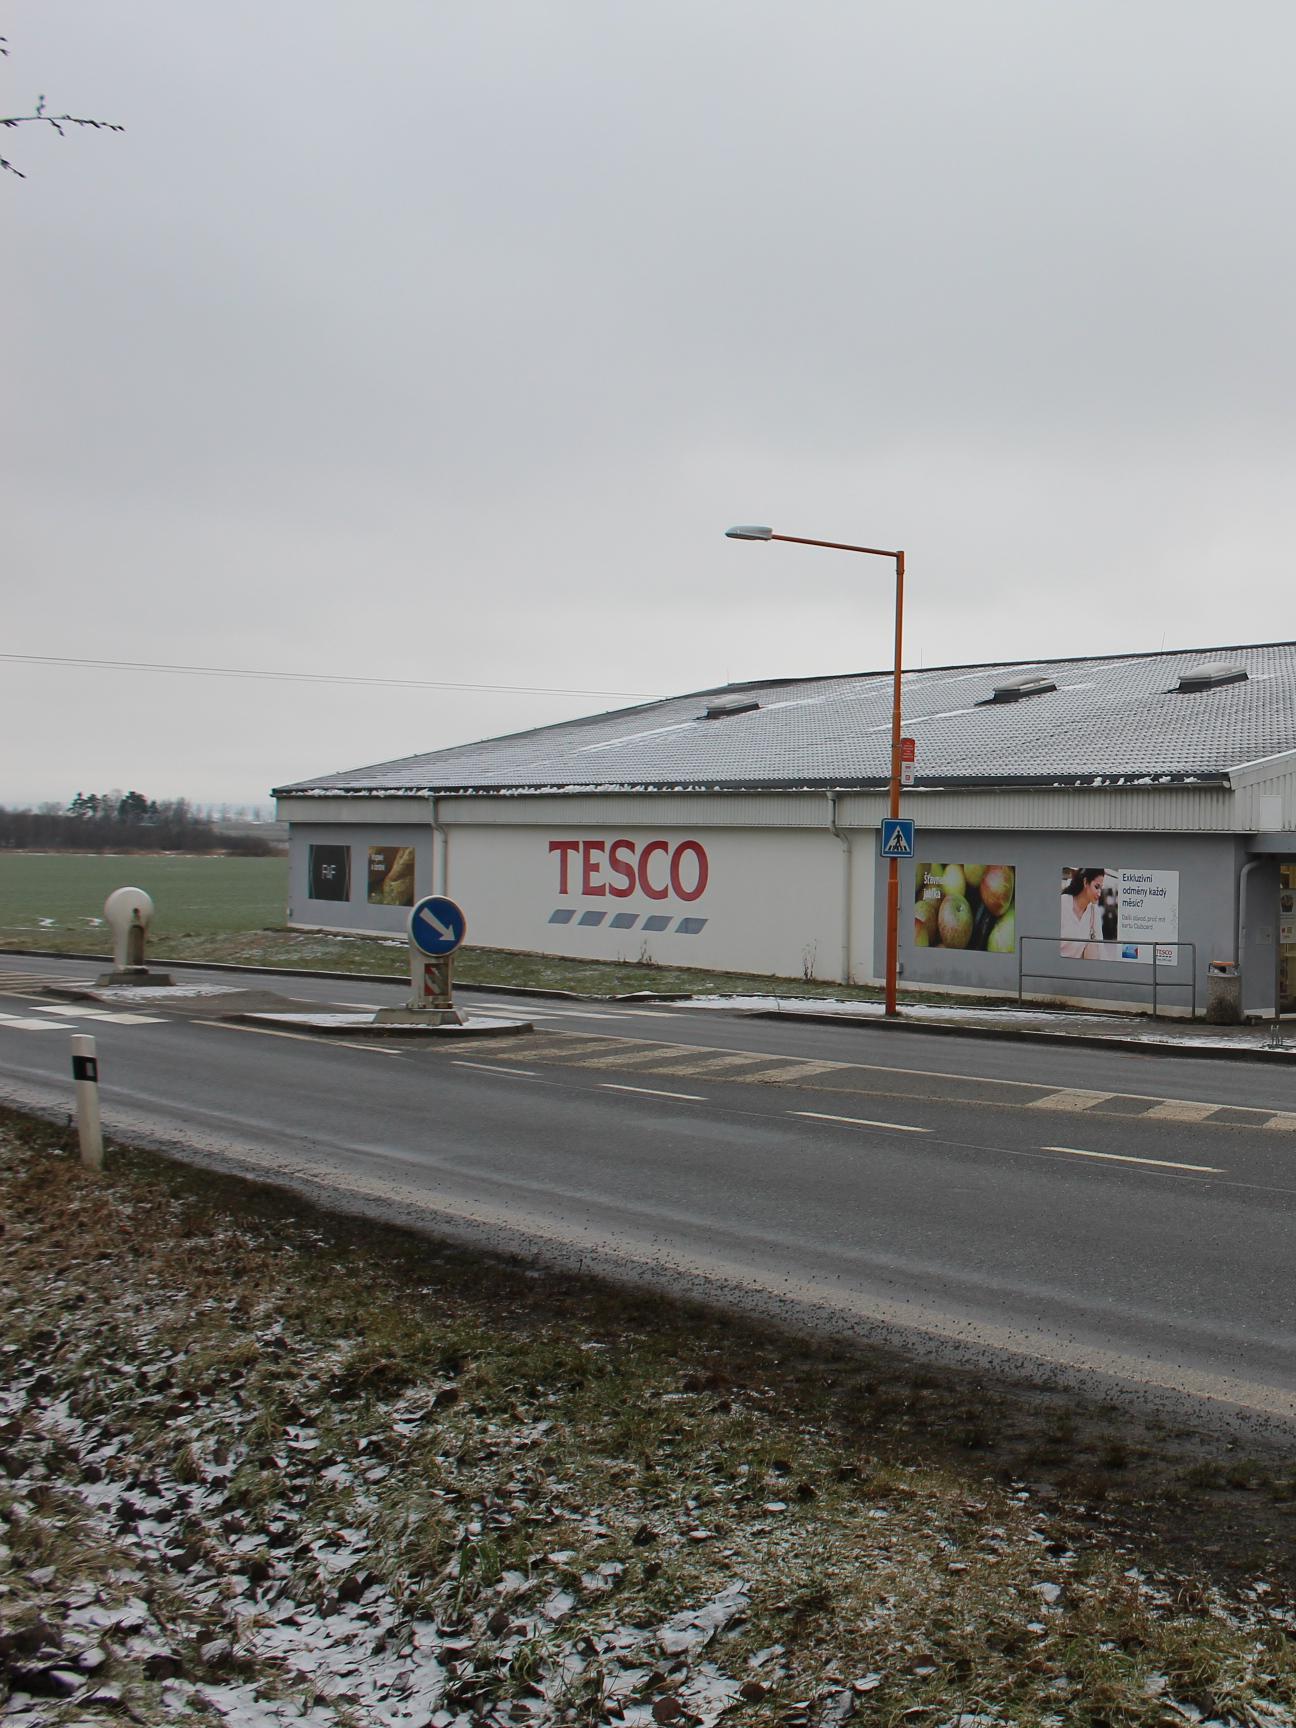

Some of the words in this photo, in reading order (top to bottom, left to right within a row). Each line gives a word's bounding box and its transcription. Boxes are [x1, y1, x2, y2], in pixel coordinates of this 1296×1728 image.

[548, 839, 709, 902] TESCO
[1122, 886, 1148, 897] odměny
[1148, 886, 1167, 898] každý
[1122, 898, 1144, 908] měsíc?
[1156, 948, 1173, 956] TESCO
